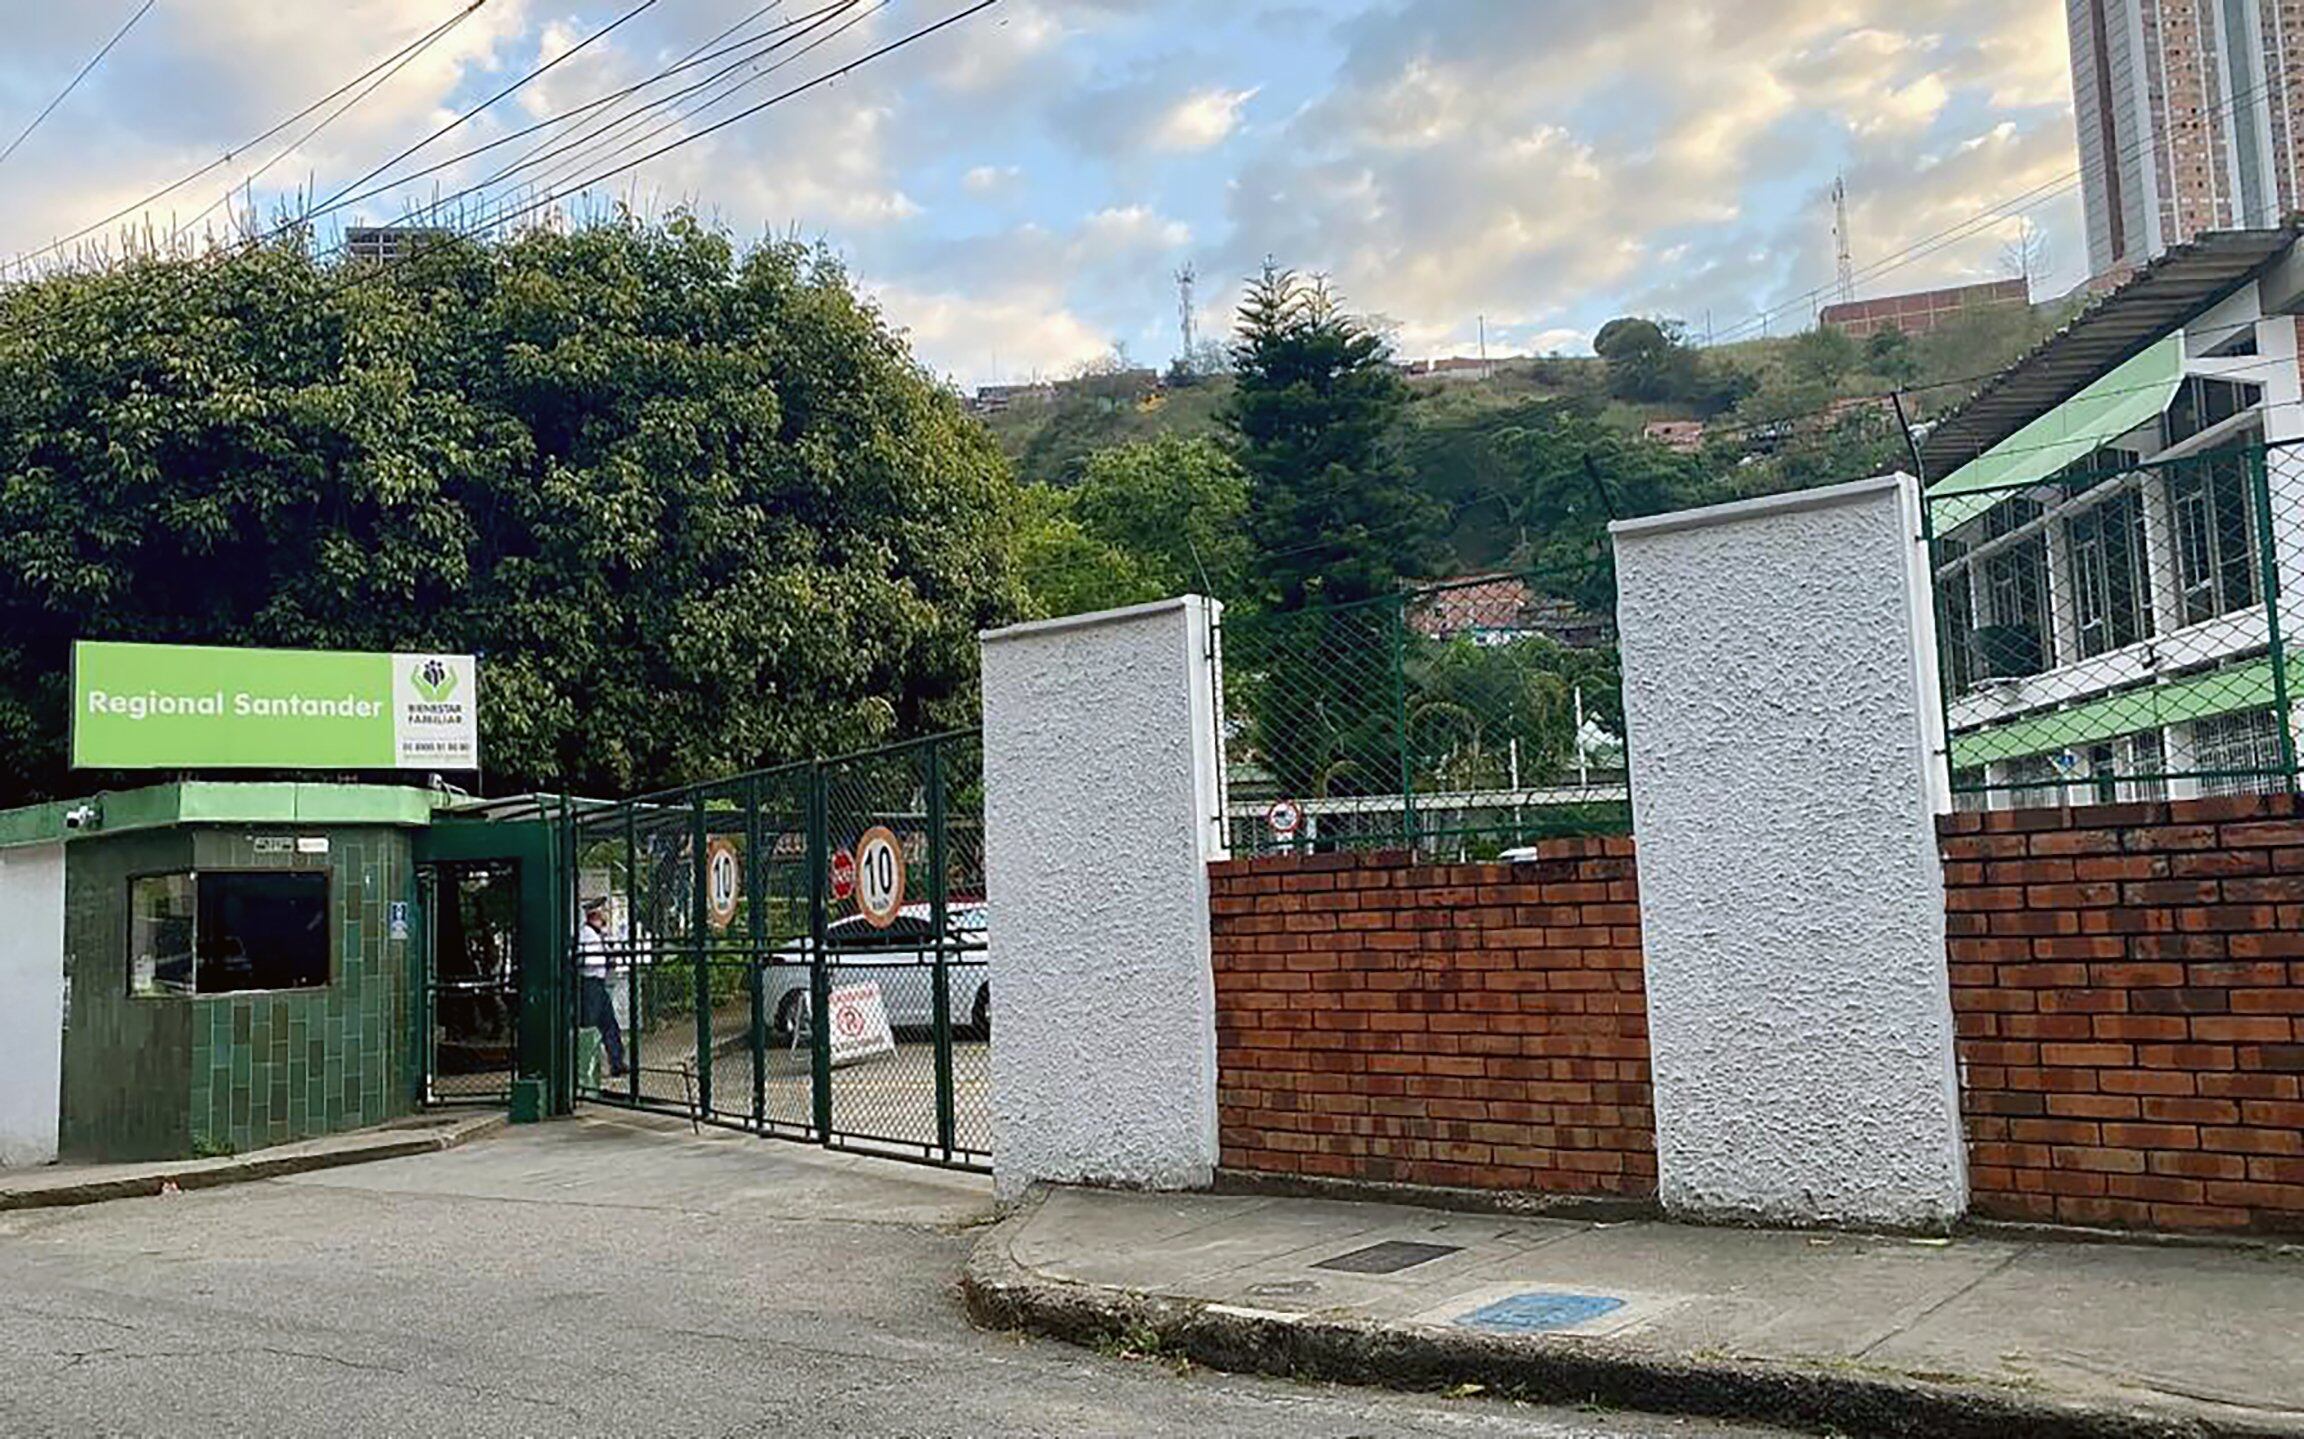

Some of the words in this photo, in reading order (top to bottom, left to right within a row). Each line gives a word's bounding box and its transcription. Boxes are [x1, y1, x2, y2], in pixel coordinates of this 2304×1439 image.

[88, 690, 224, 720] Regional
[233, 692, 383, 718] Santander
[713, 855, 732, 898] 10
[864, 845, 892, 896] 10
